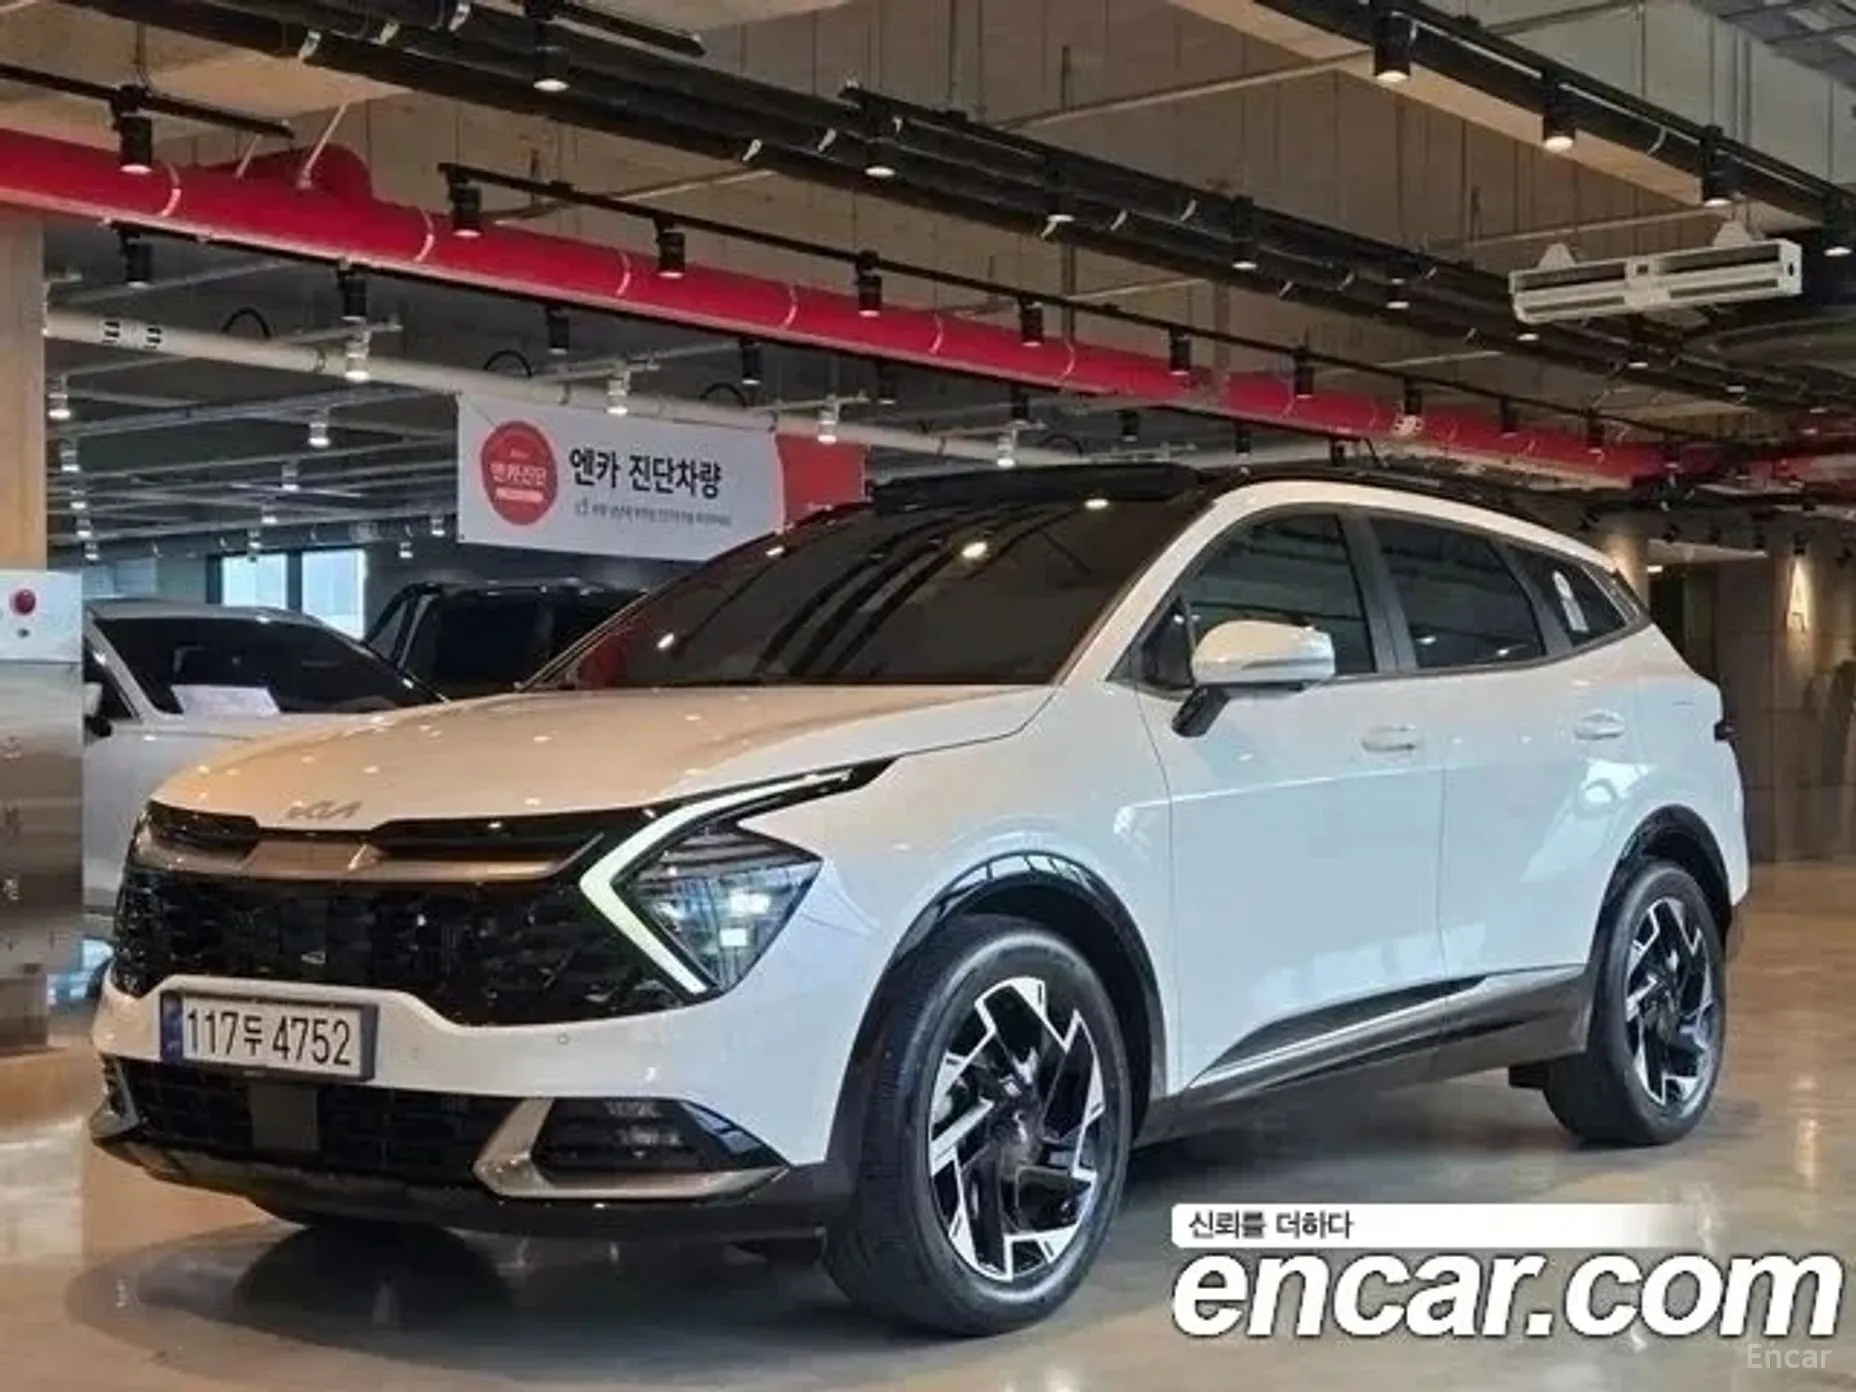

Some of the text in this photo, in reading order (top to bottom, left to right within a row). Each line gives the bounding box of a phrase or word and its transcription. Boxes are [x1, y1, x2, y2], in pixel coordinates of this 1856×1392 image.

[569, 448, 722, 498] 엔카 진단차량
[187, 1008, 351, 1066] 117두 4752
